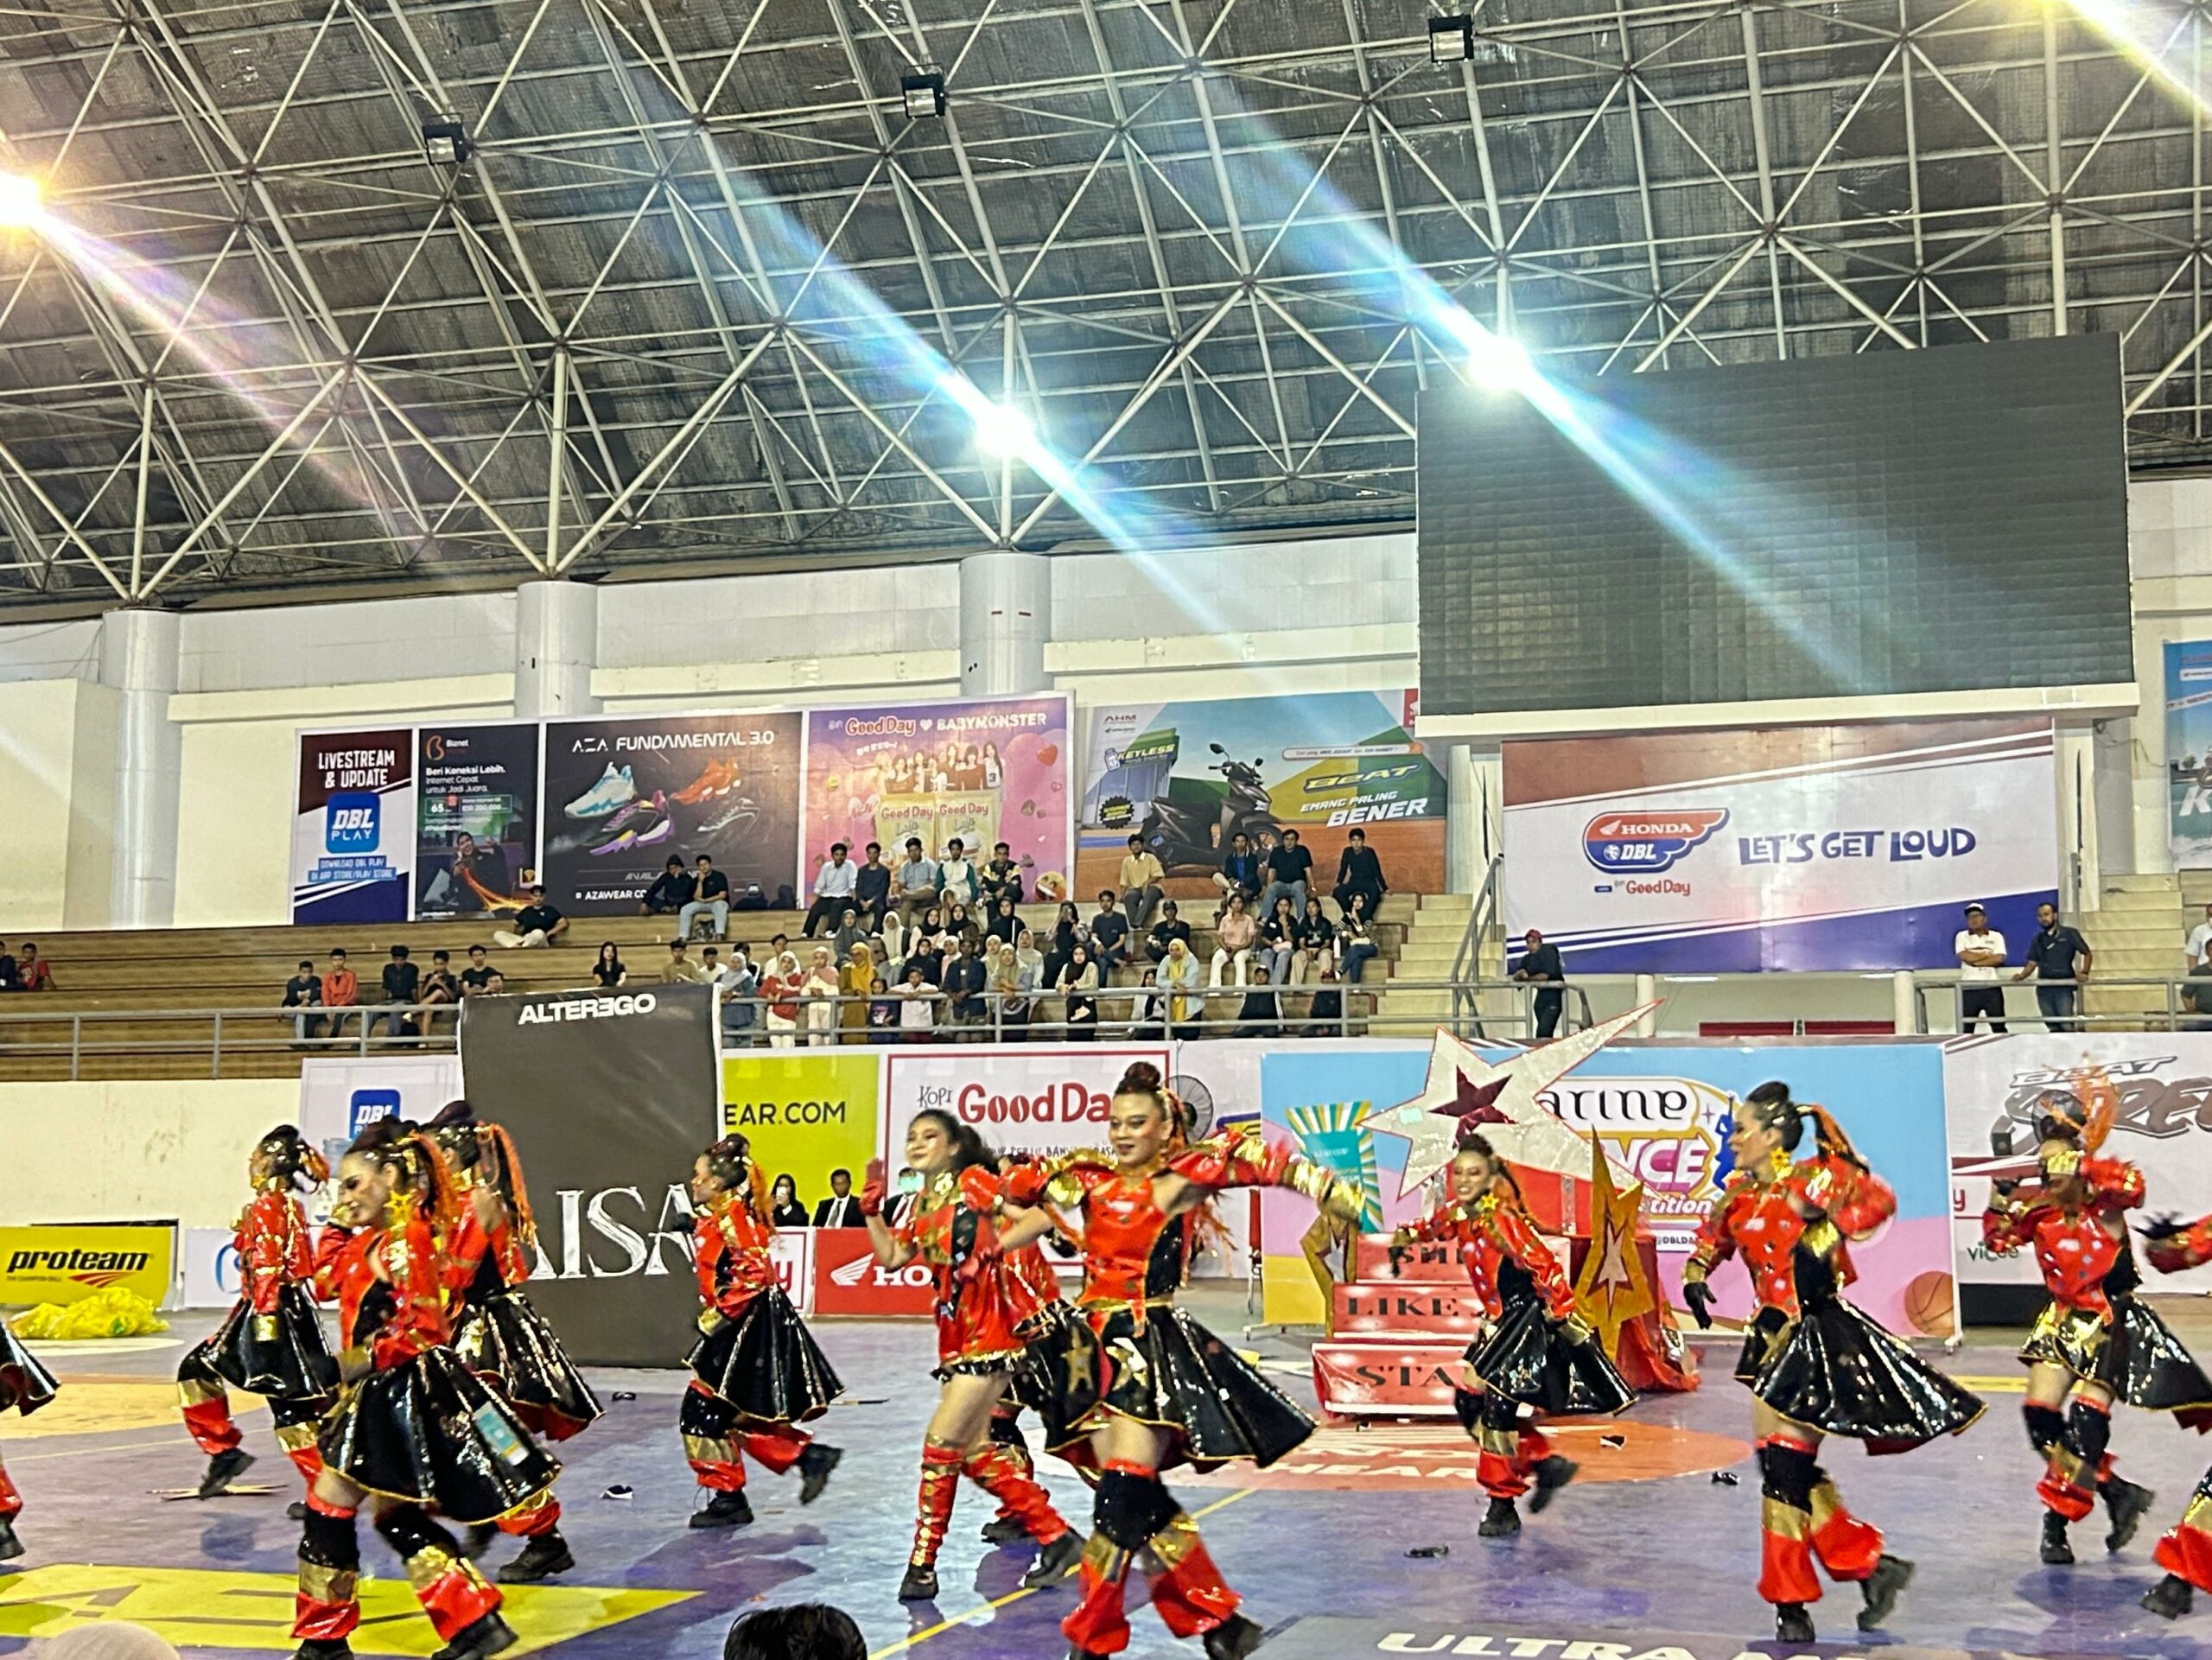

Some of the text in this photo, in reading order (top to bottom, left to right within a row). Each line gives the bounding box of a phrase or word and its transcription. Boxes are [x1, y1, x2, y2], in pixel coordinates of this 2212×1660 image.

[846, 717, 885, 735] Good
[886, 716, 916, 737] Day
[937, 713, 1046, 731] BABYMONSTER
[616, 733, 746, 751] FUNDAMENTAL
[749, 731, 774, 745] 3.0
[1117, 744, 1175, 760] KEYLESS
[325, 768, 388, 788] & UPDATE
[445, 766, 478, 774] Koneksi
[988, 773, 996, 782] 3
[431, 803, 444, 812] 65
[939, 802, 989, 817] Good Day
[1300, 791, 1398, 813] EMANG PALING
[332, 809, 375, 830] DBL
[881, 806, 911, 820] Good
[912, 805, 934, 821] Day
[1326, 798, 1428, 828] BENER
[331, 830, 373, 842] PLAY
[1621, 824, 1694, 835] HONDA
[1620, 843, 1657, 861] DBL
[1738, 827, 1976, 865] LET'S GET LOUD
[1625, 881, 1662, 894] Good
[1663, 879, 1691, 896] Day
[957, 1082, 1112, 1123] Good Da
[724, 1101, 846, 1125] EAR.COM
[1599, 1137, 1712, 1190] NCE
[6, 1249, 149, 1274] proteam
[1348, 1298, 1459, 1316] LIKE
[1356, 1366, 1455, 1387] STA
[1377, 1632, 1699, 1660] ULTRA
